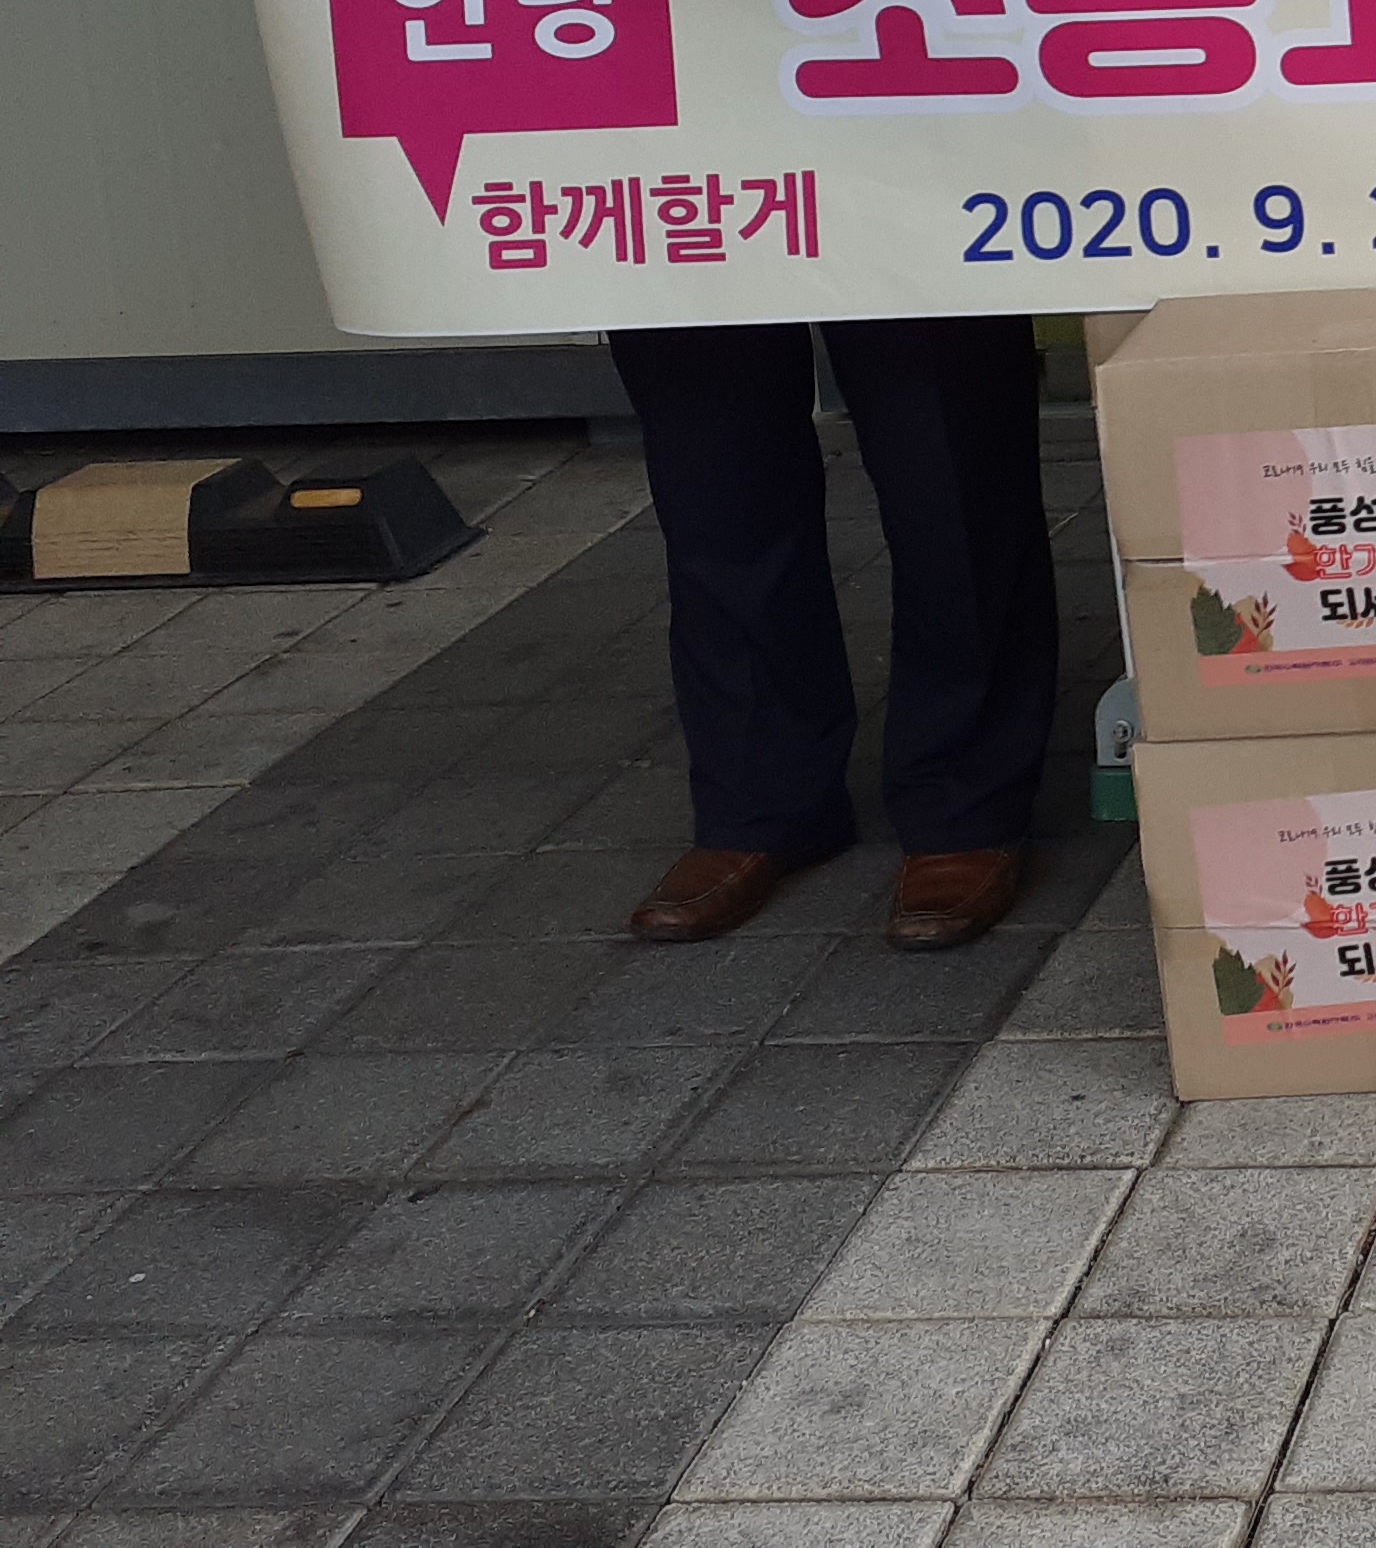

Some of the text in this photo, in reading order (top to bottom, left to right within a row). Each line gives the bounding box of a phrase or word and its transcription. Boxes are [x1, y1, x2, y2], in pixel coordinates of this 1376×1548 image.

[471, 168, 820, 271] 함께할게
[961, 187, 1222, 264] 2020.
[1252, 184, 1338, 256] 9.
